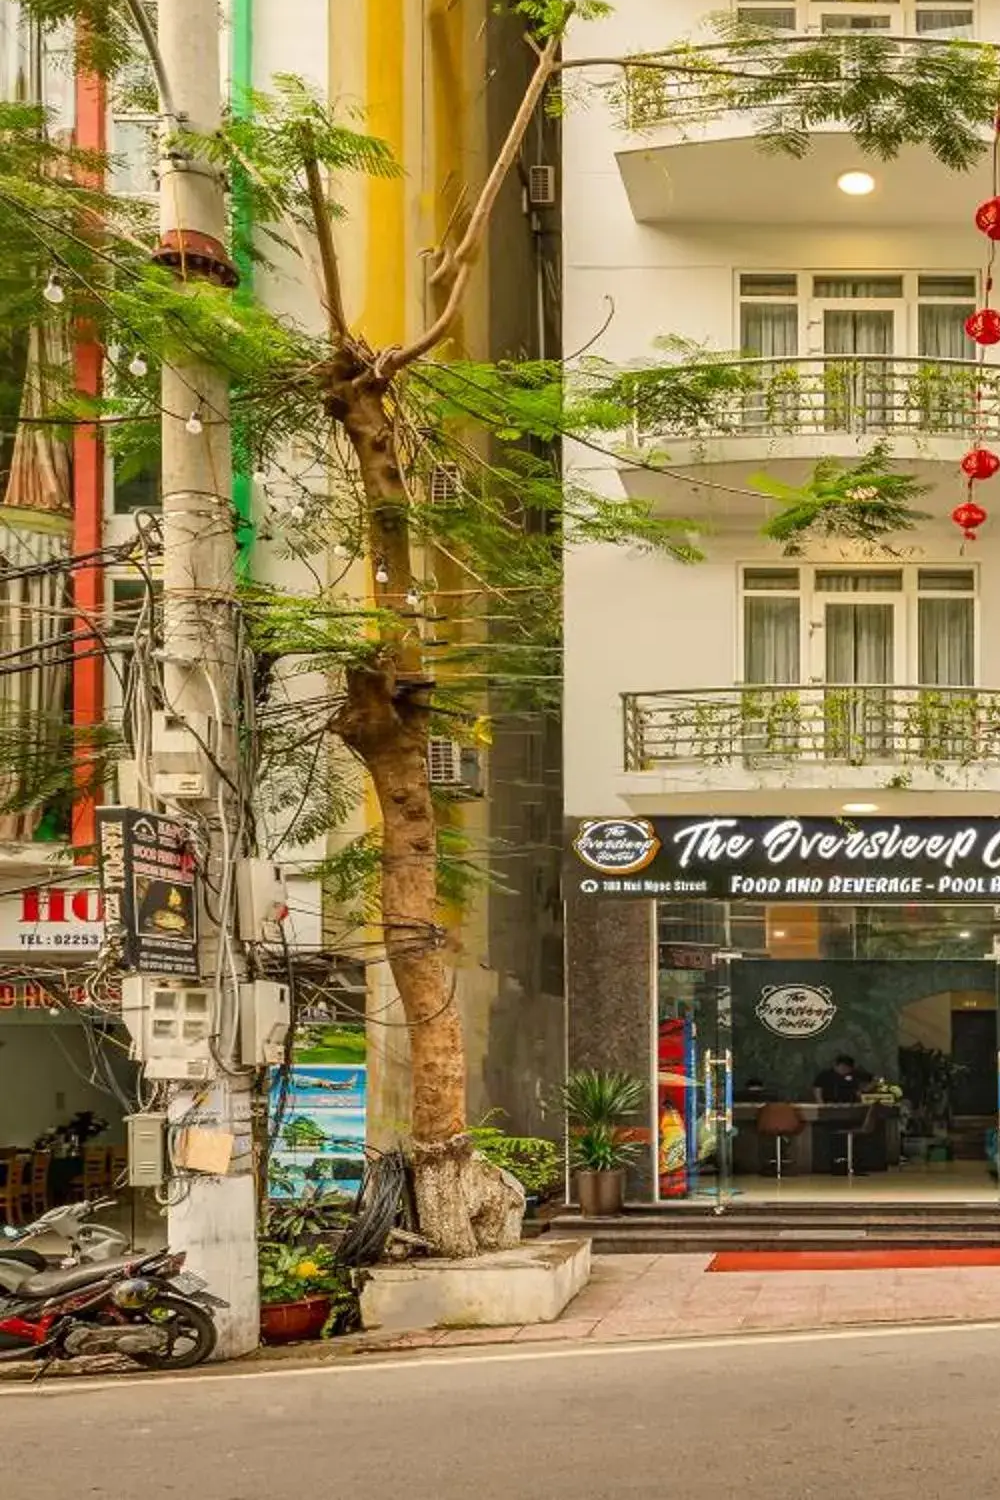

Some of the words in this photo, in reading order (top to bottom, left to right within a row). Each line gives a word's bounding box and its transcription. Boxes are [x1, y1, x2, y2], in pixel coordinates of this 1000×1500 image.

[673, 819, 754, 869] The
[762, 819, 978, 869] Oversleep
[673, 880, 707, 891] Street
[731, 875, 781, 894] FOOD
[785, 875, 823, 894] AND
[827, 875, 923, 894] BEVERAGE
[938, 875, 985, 894] POOL
